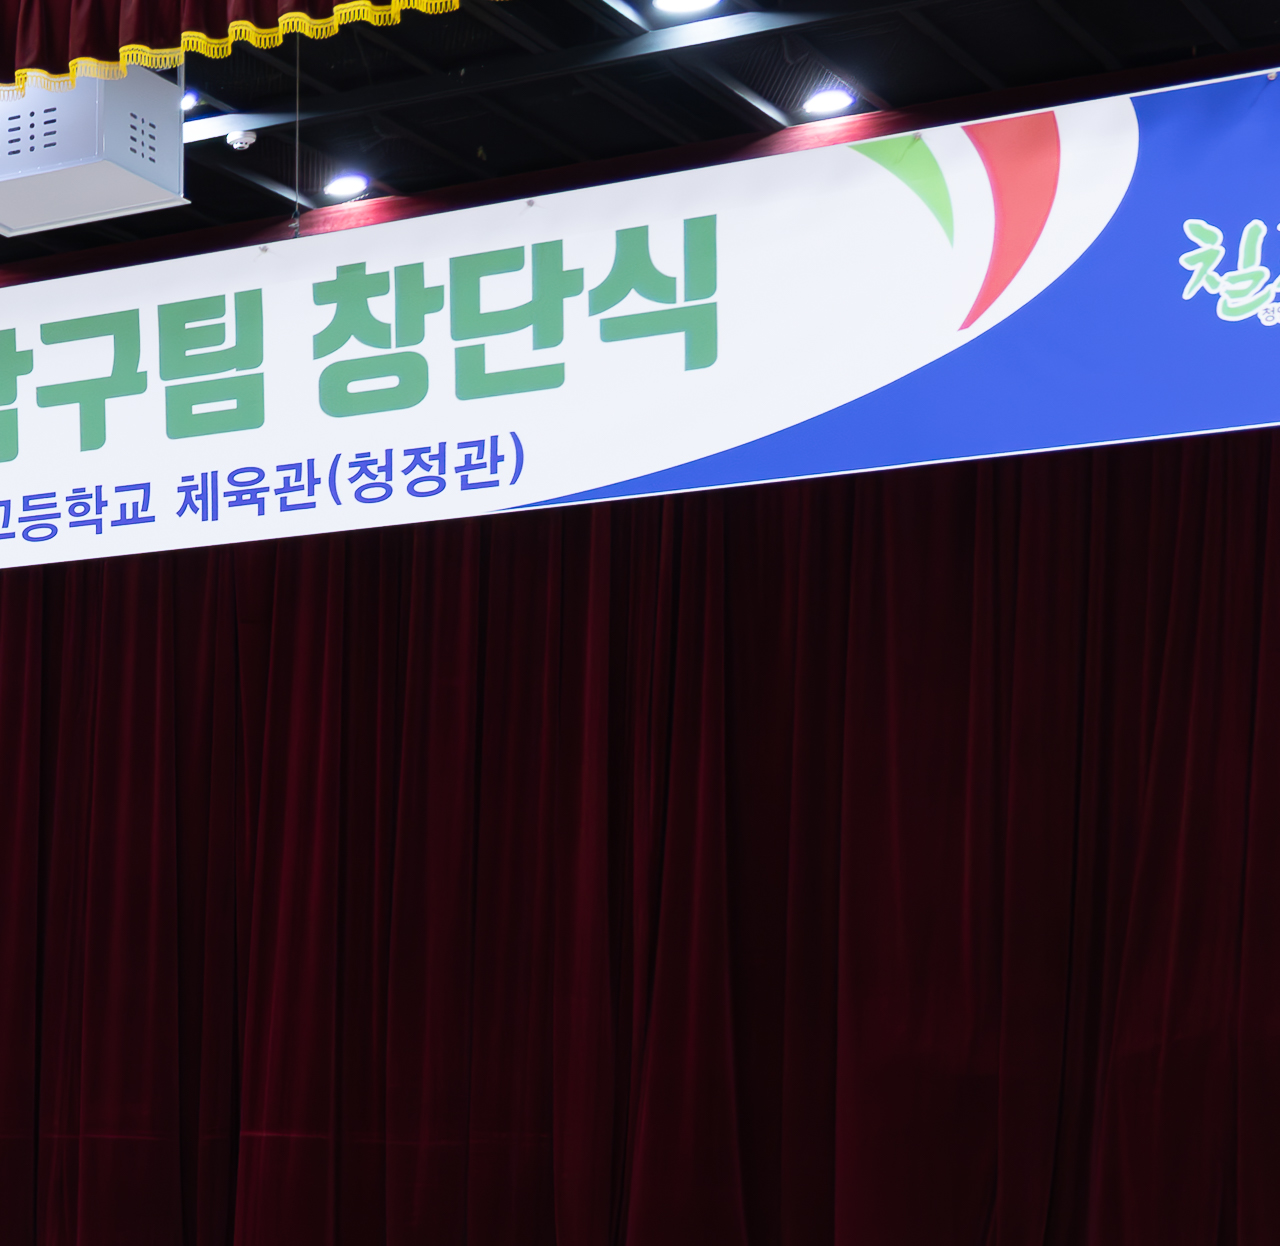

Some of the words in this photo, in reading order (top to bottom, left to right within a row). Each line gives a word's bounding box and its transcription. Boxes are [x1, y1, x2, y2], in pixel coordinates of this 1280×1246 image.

[314, 215, 718, 416] 창단식
[1179, 219, 1280, 322] 칠
[175, 431, 525, 523] 체육관(청정관)
